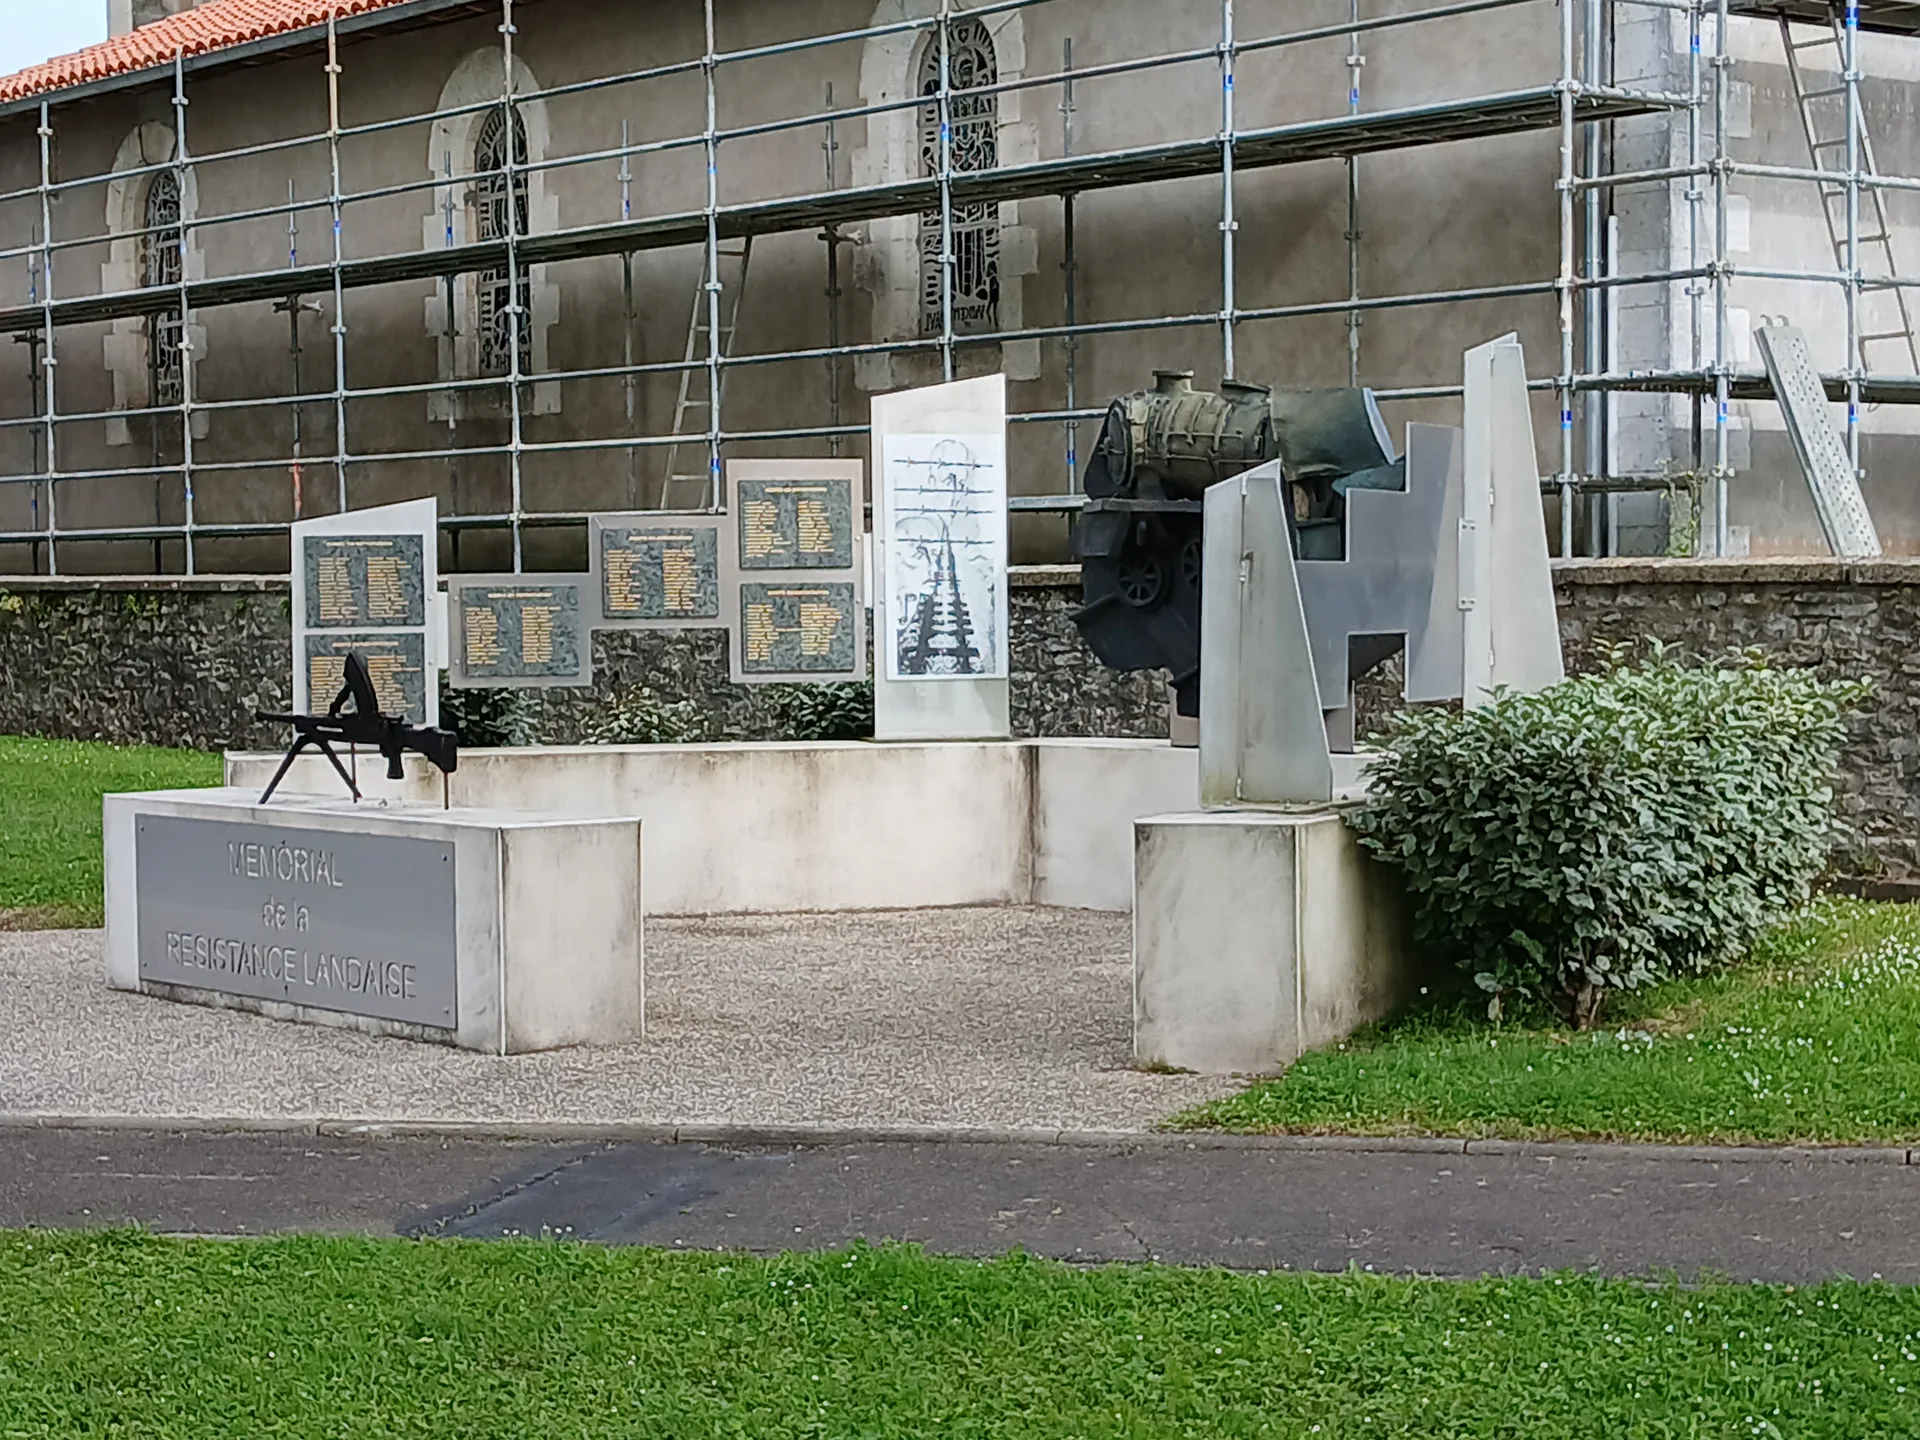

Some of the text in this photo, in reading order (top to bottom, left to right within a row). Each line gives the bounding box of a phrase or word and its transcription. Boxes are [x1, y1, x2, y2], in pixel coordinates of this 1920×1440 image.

[263, 895, 309, 932] de la
[166, 931, 417, 999] RESISTANCE LANDAISE
